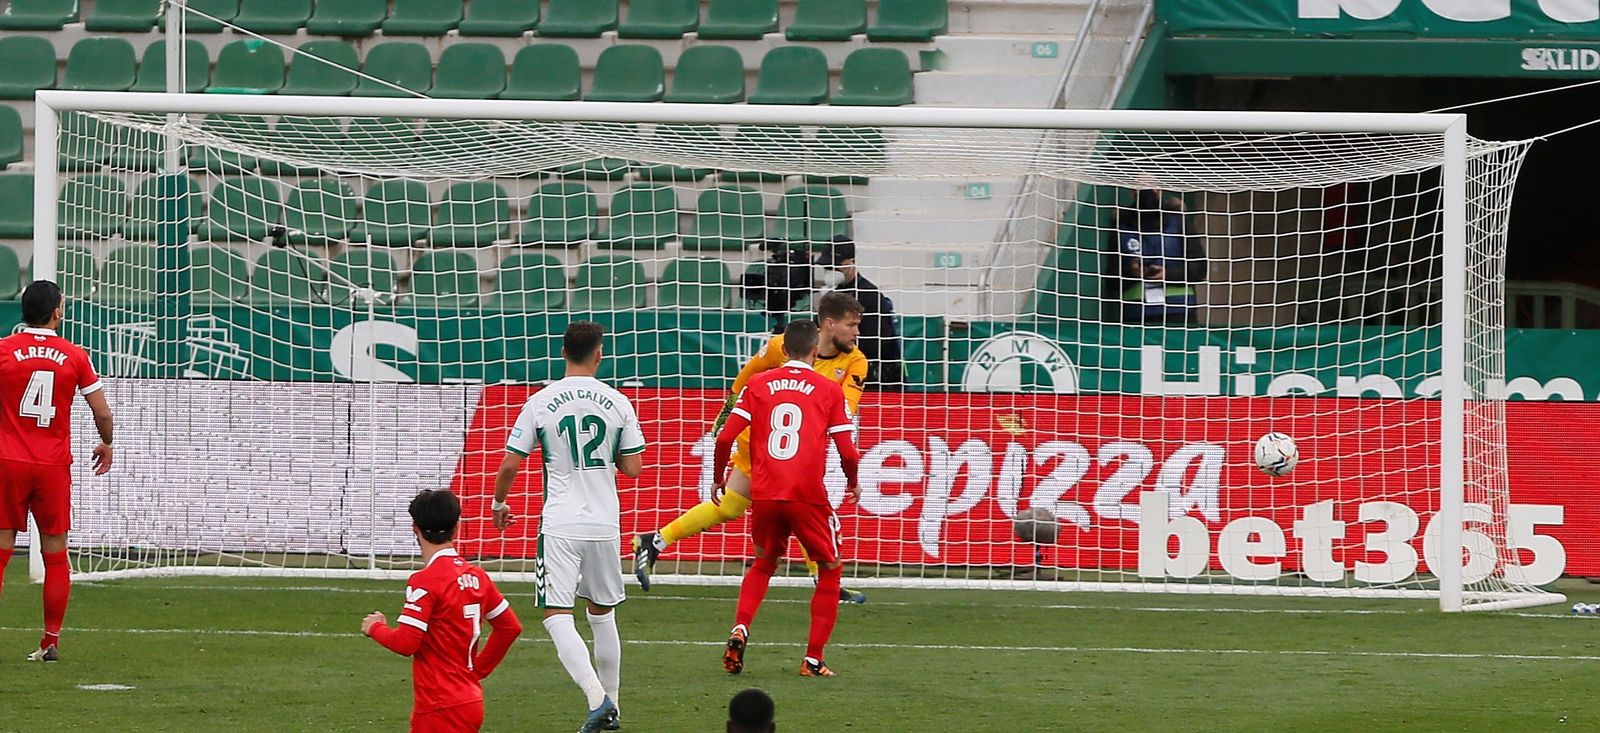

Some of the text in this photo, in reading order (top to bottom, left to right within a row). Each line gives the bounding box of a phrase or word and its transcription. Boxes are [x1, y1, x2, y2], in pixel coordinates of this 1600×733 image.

[1520, 47, 1600, 70] SALID
[14, 346, 68, 366] K.REKIK
[19, 370, 57, 428] 4
[546, 389, 614, 413] DANI CALVO
[767, 379, 815, 396] JORDÁN
[556, 414, 607, 470] 12
[767, 402, 802, 460] 8
[1138, 491, 1567, 586] bet365
[457, 573, 480, 591] SUSO
[463, 603, 481, 671] 7
